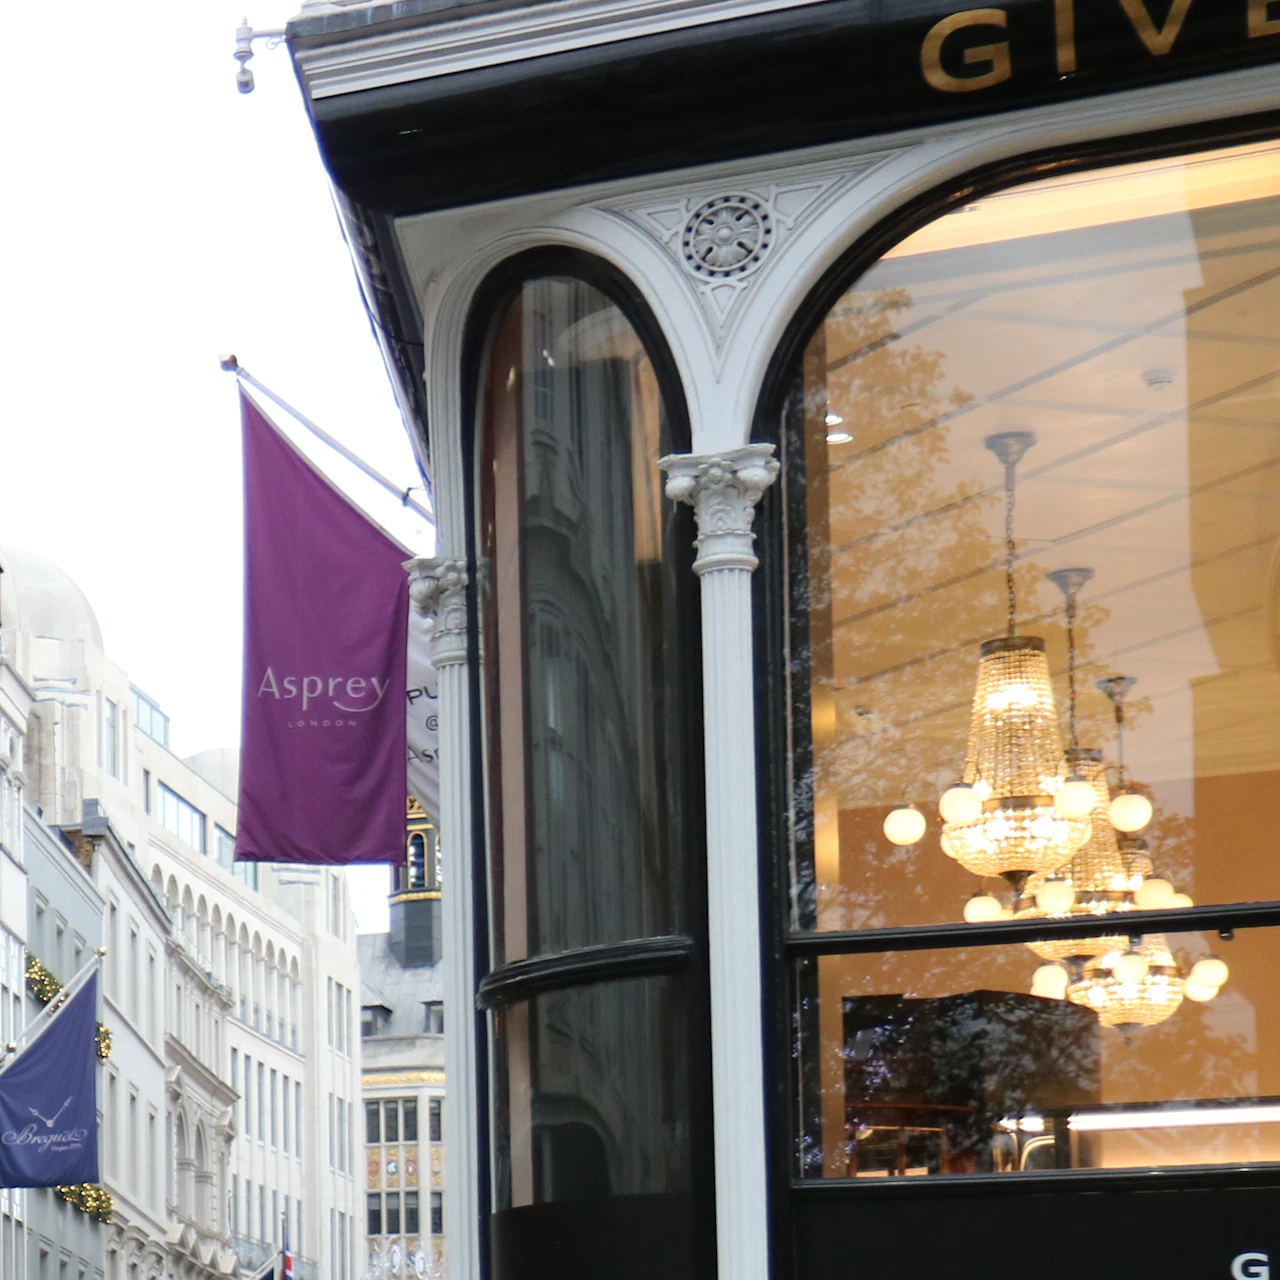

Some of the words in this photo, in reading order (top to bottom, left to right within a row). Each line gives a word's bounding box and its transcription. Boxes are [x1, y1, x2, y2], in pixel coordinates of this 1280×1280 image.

[256, 665, 391, 713] Asprey
[287, 719, 358, 729] LONDON
[1, 1122, 88, 1153] Breguet
